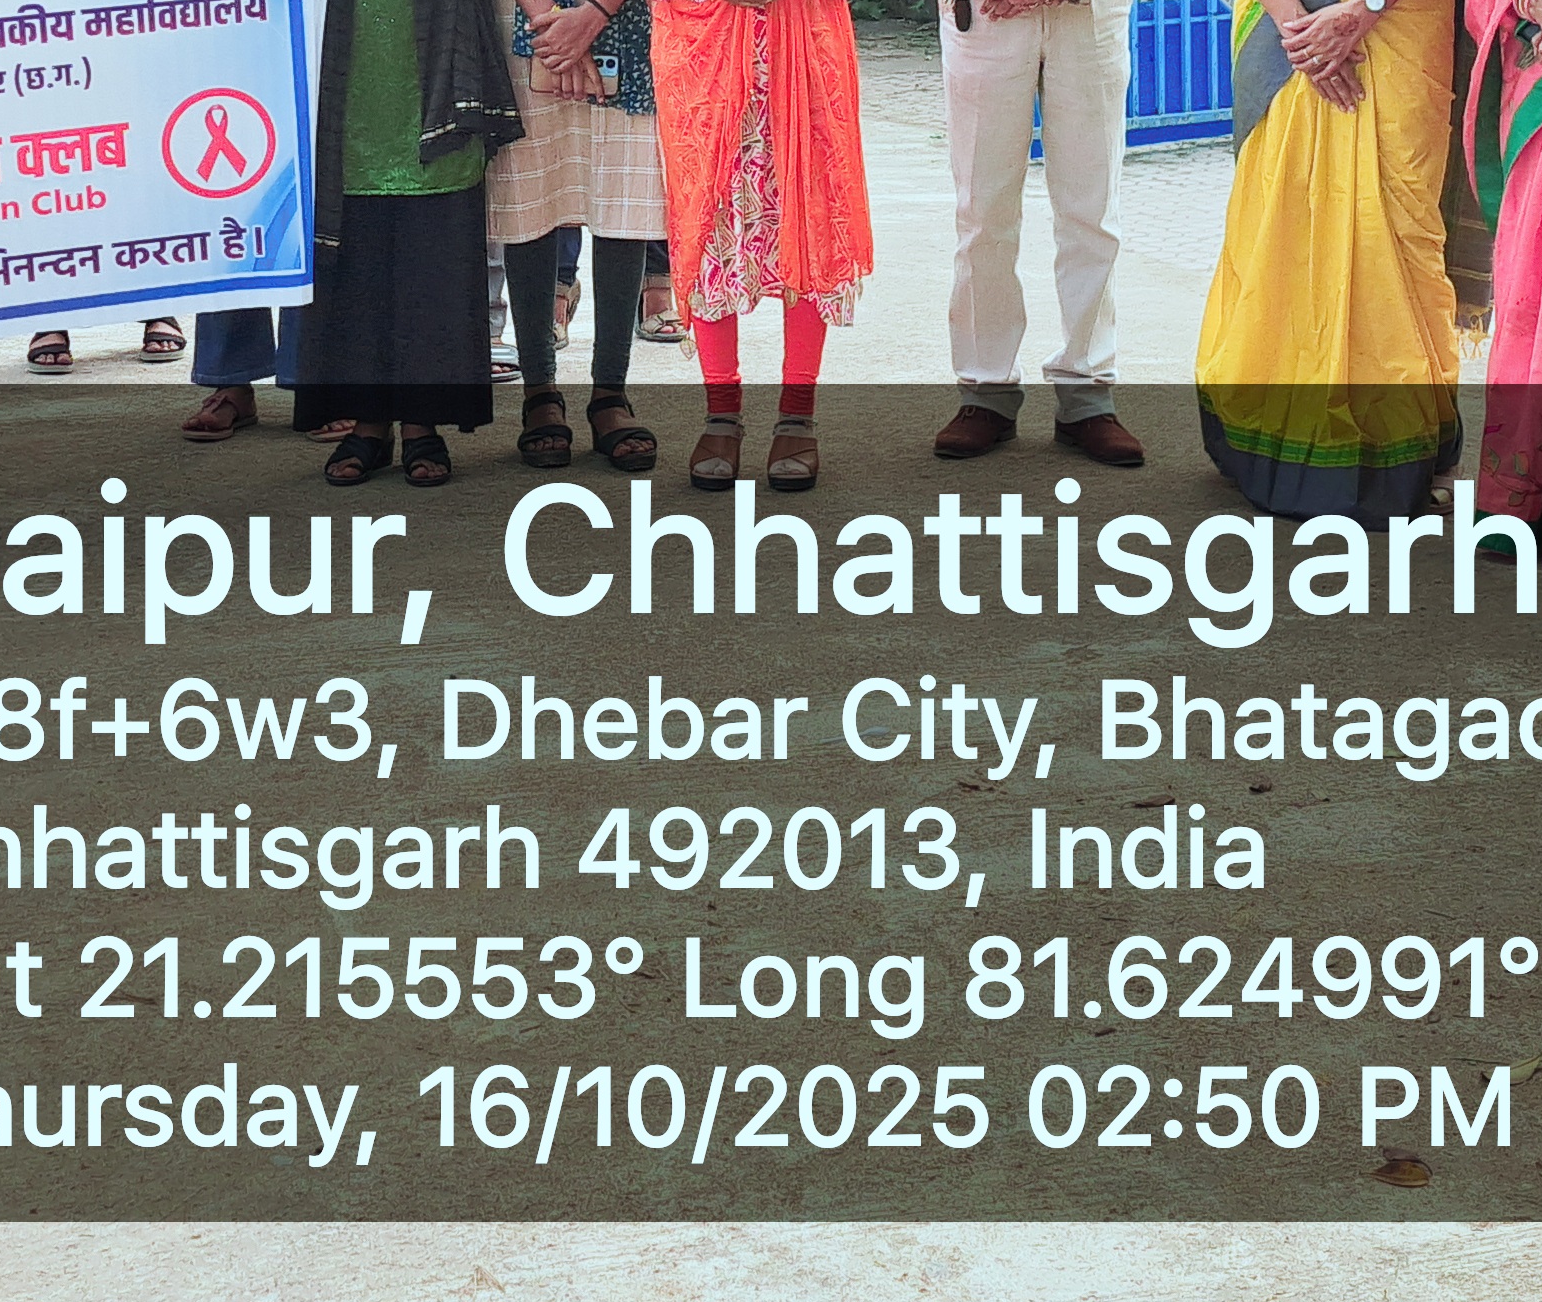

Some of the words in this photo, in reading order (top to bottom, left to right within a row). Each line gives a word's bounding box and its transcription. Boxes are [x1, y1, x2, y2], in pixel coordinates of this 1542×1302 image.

[14, 56, 92, 97] (छ.ग.)
[9, 122, 130, 178] क्लब
[31, 185, 108, 216] Club
[111, 231, 212, 270] करता
